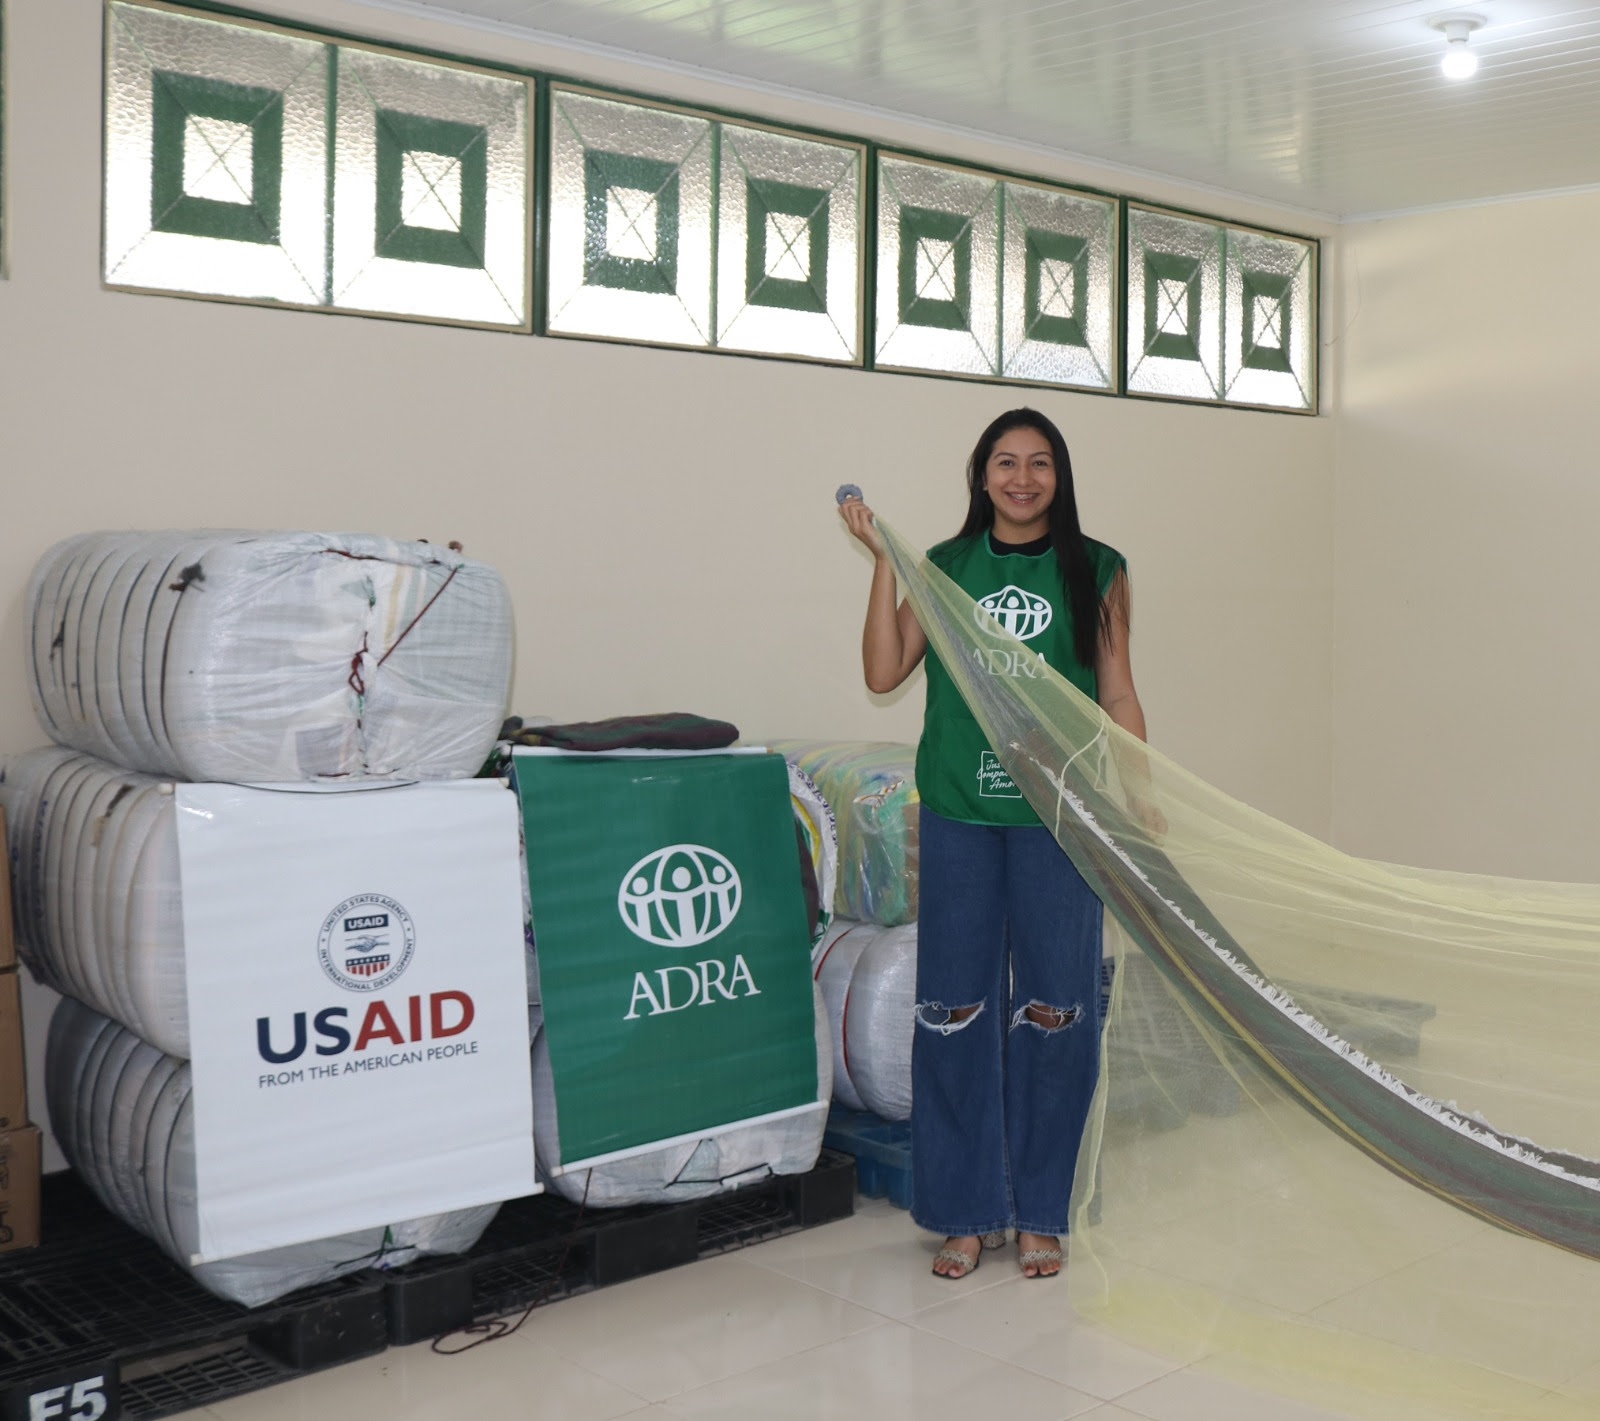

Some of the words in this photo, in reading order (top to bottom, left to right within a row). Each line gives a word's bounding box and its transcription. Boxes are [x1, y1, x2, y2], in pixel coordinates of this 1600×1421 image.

[973, 648, 1052, 679] ADRA
[323, 904, 348, 932] UNITED
[349, 896, 380, 906] STATES
[380, 899, 408, 922] AGENCY
[347, 916, 385, 930] USAID
[320, 949, 371, 990] INTERNATIONAL
[373, 938, 413, 988] DEVELOPMENT
[623, 954, 762, 1020] ADRA
[256, 989, 475, 1064] USAID
[258, 1069, 305, 1089] FROM
[308, 1063, 339, 1080] THE
[343, 1049, 423, 1074] AMERICAN
[427, 1041, 479, 1060] PEOPLE
